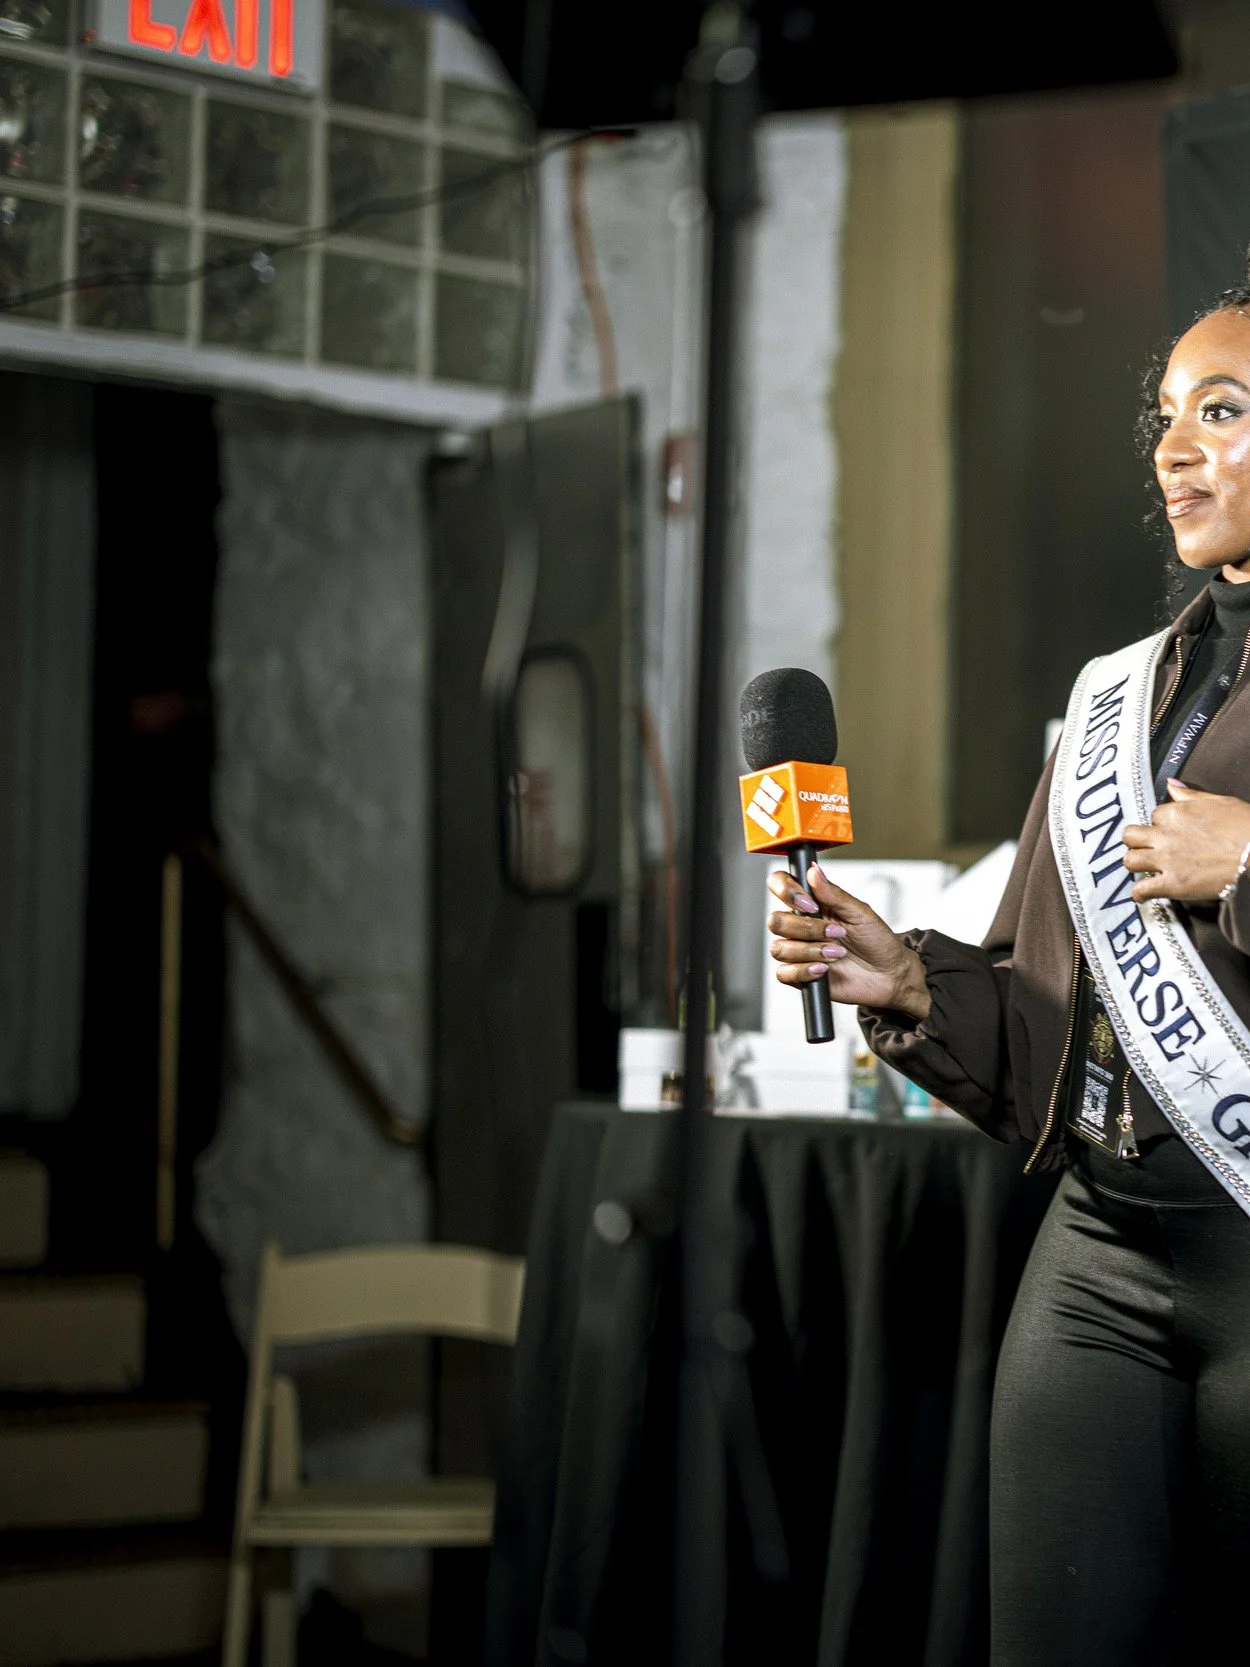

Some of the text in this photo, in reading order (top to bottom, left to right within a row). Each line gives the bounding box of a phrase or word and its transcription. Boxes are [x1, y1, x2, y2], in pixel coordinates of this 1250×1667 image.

[1075, 674, 1131, 782] MISS
[1168, 712, 1208, 764] NYFWAM
[1075, 770, 1208, 1063] UNIVERSE
